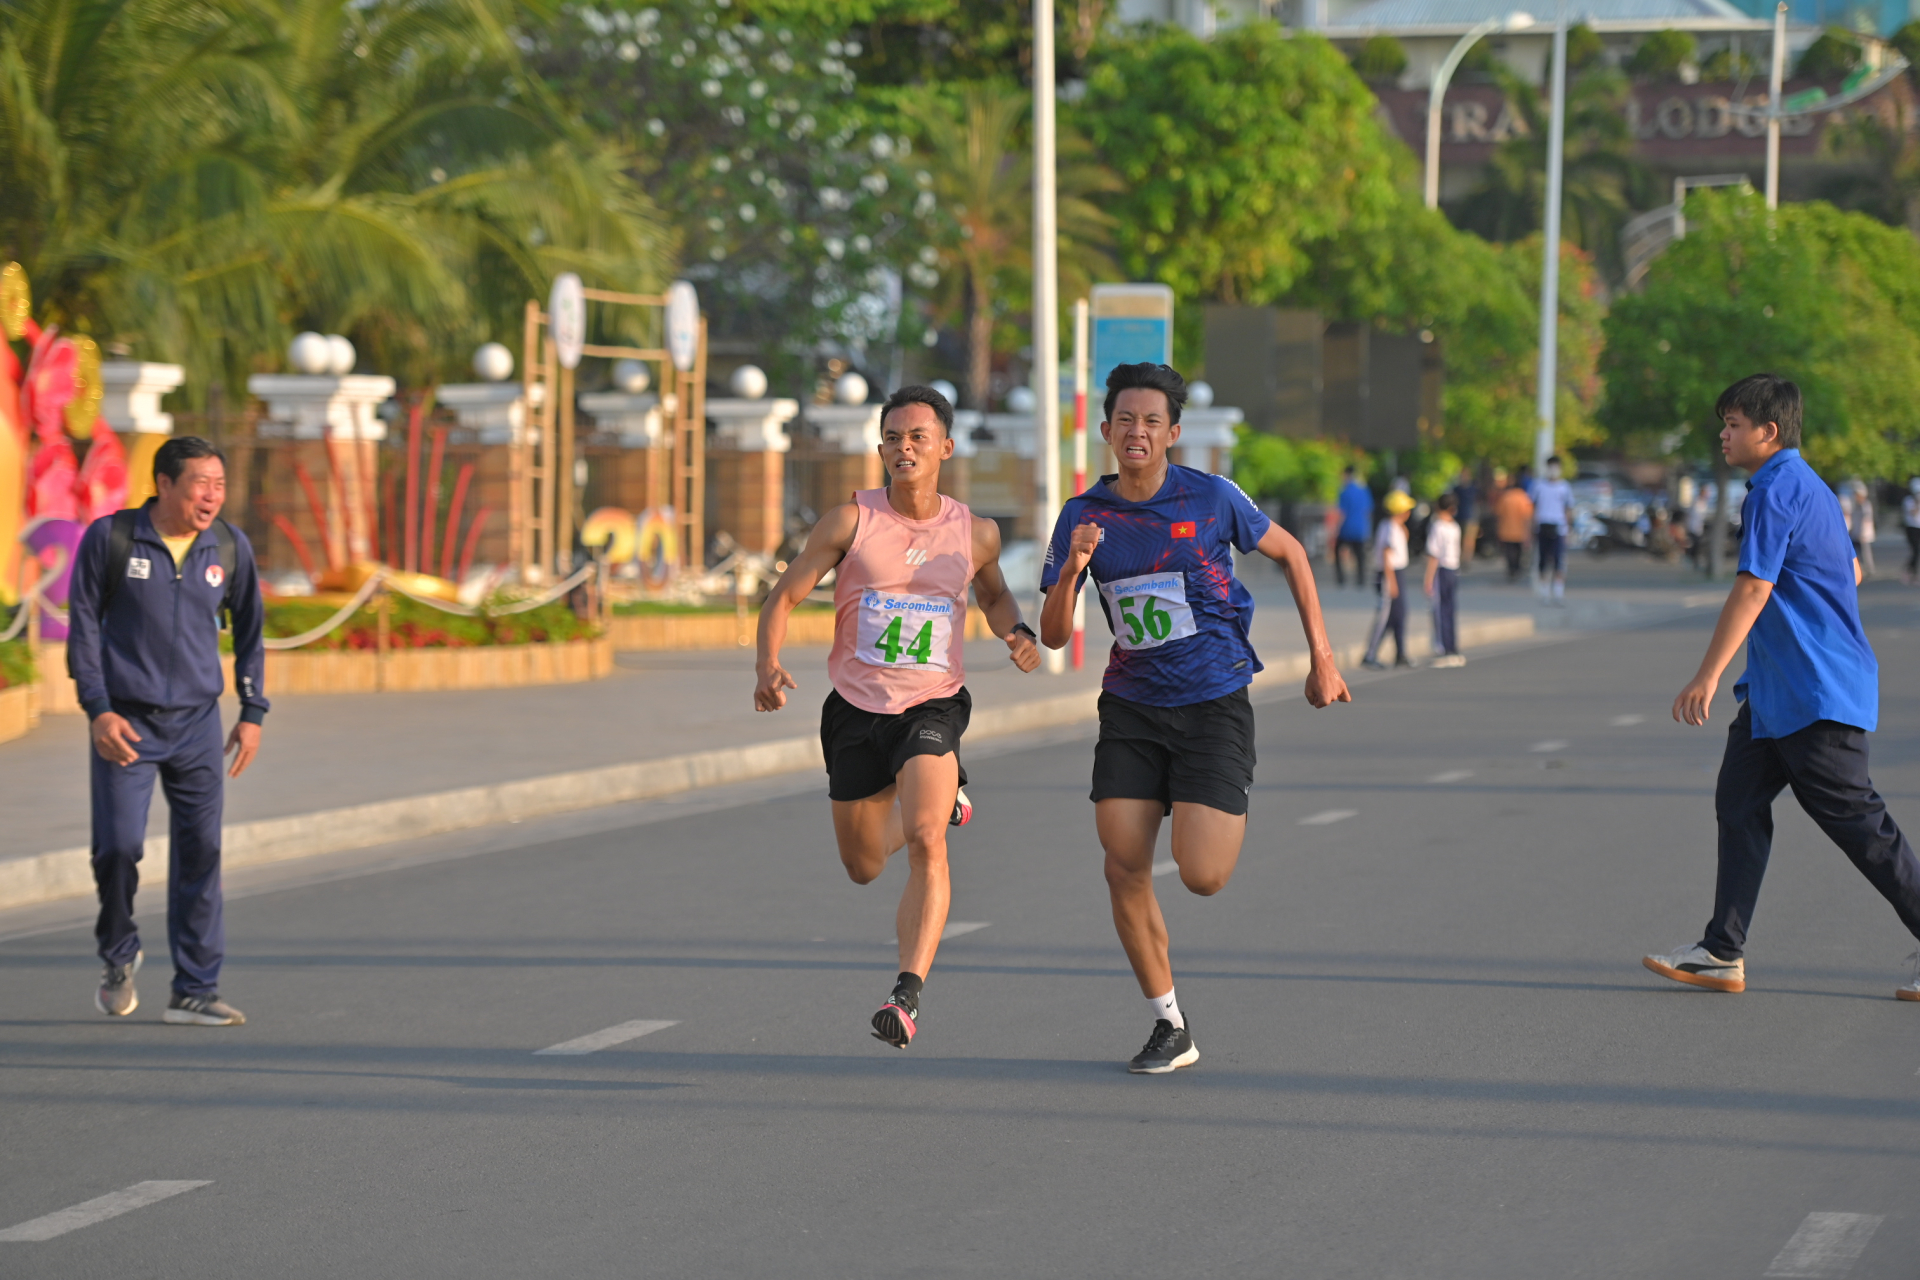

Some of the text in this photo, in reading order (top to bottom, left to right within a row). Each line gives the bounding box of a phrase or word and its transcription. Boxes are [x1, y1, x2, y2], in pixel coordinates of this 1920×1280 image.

[1114, 577, 1179, 595] Sacombank
[884, 598, 950, 613] Sacombank
[1117, 595, 1172, 645] 56
[874, 615, 933, 664] 44
